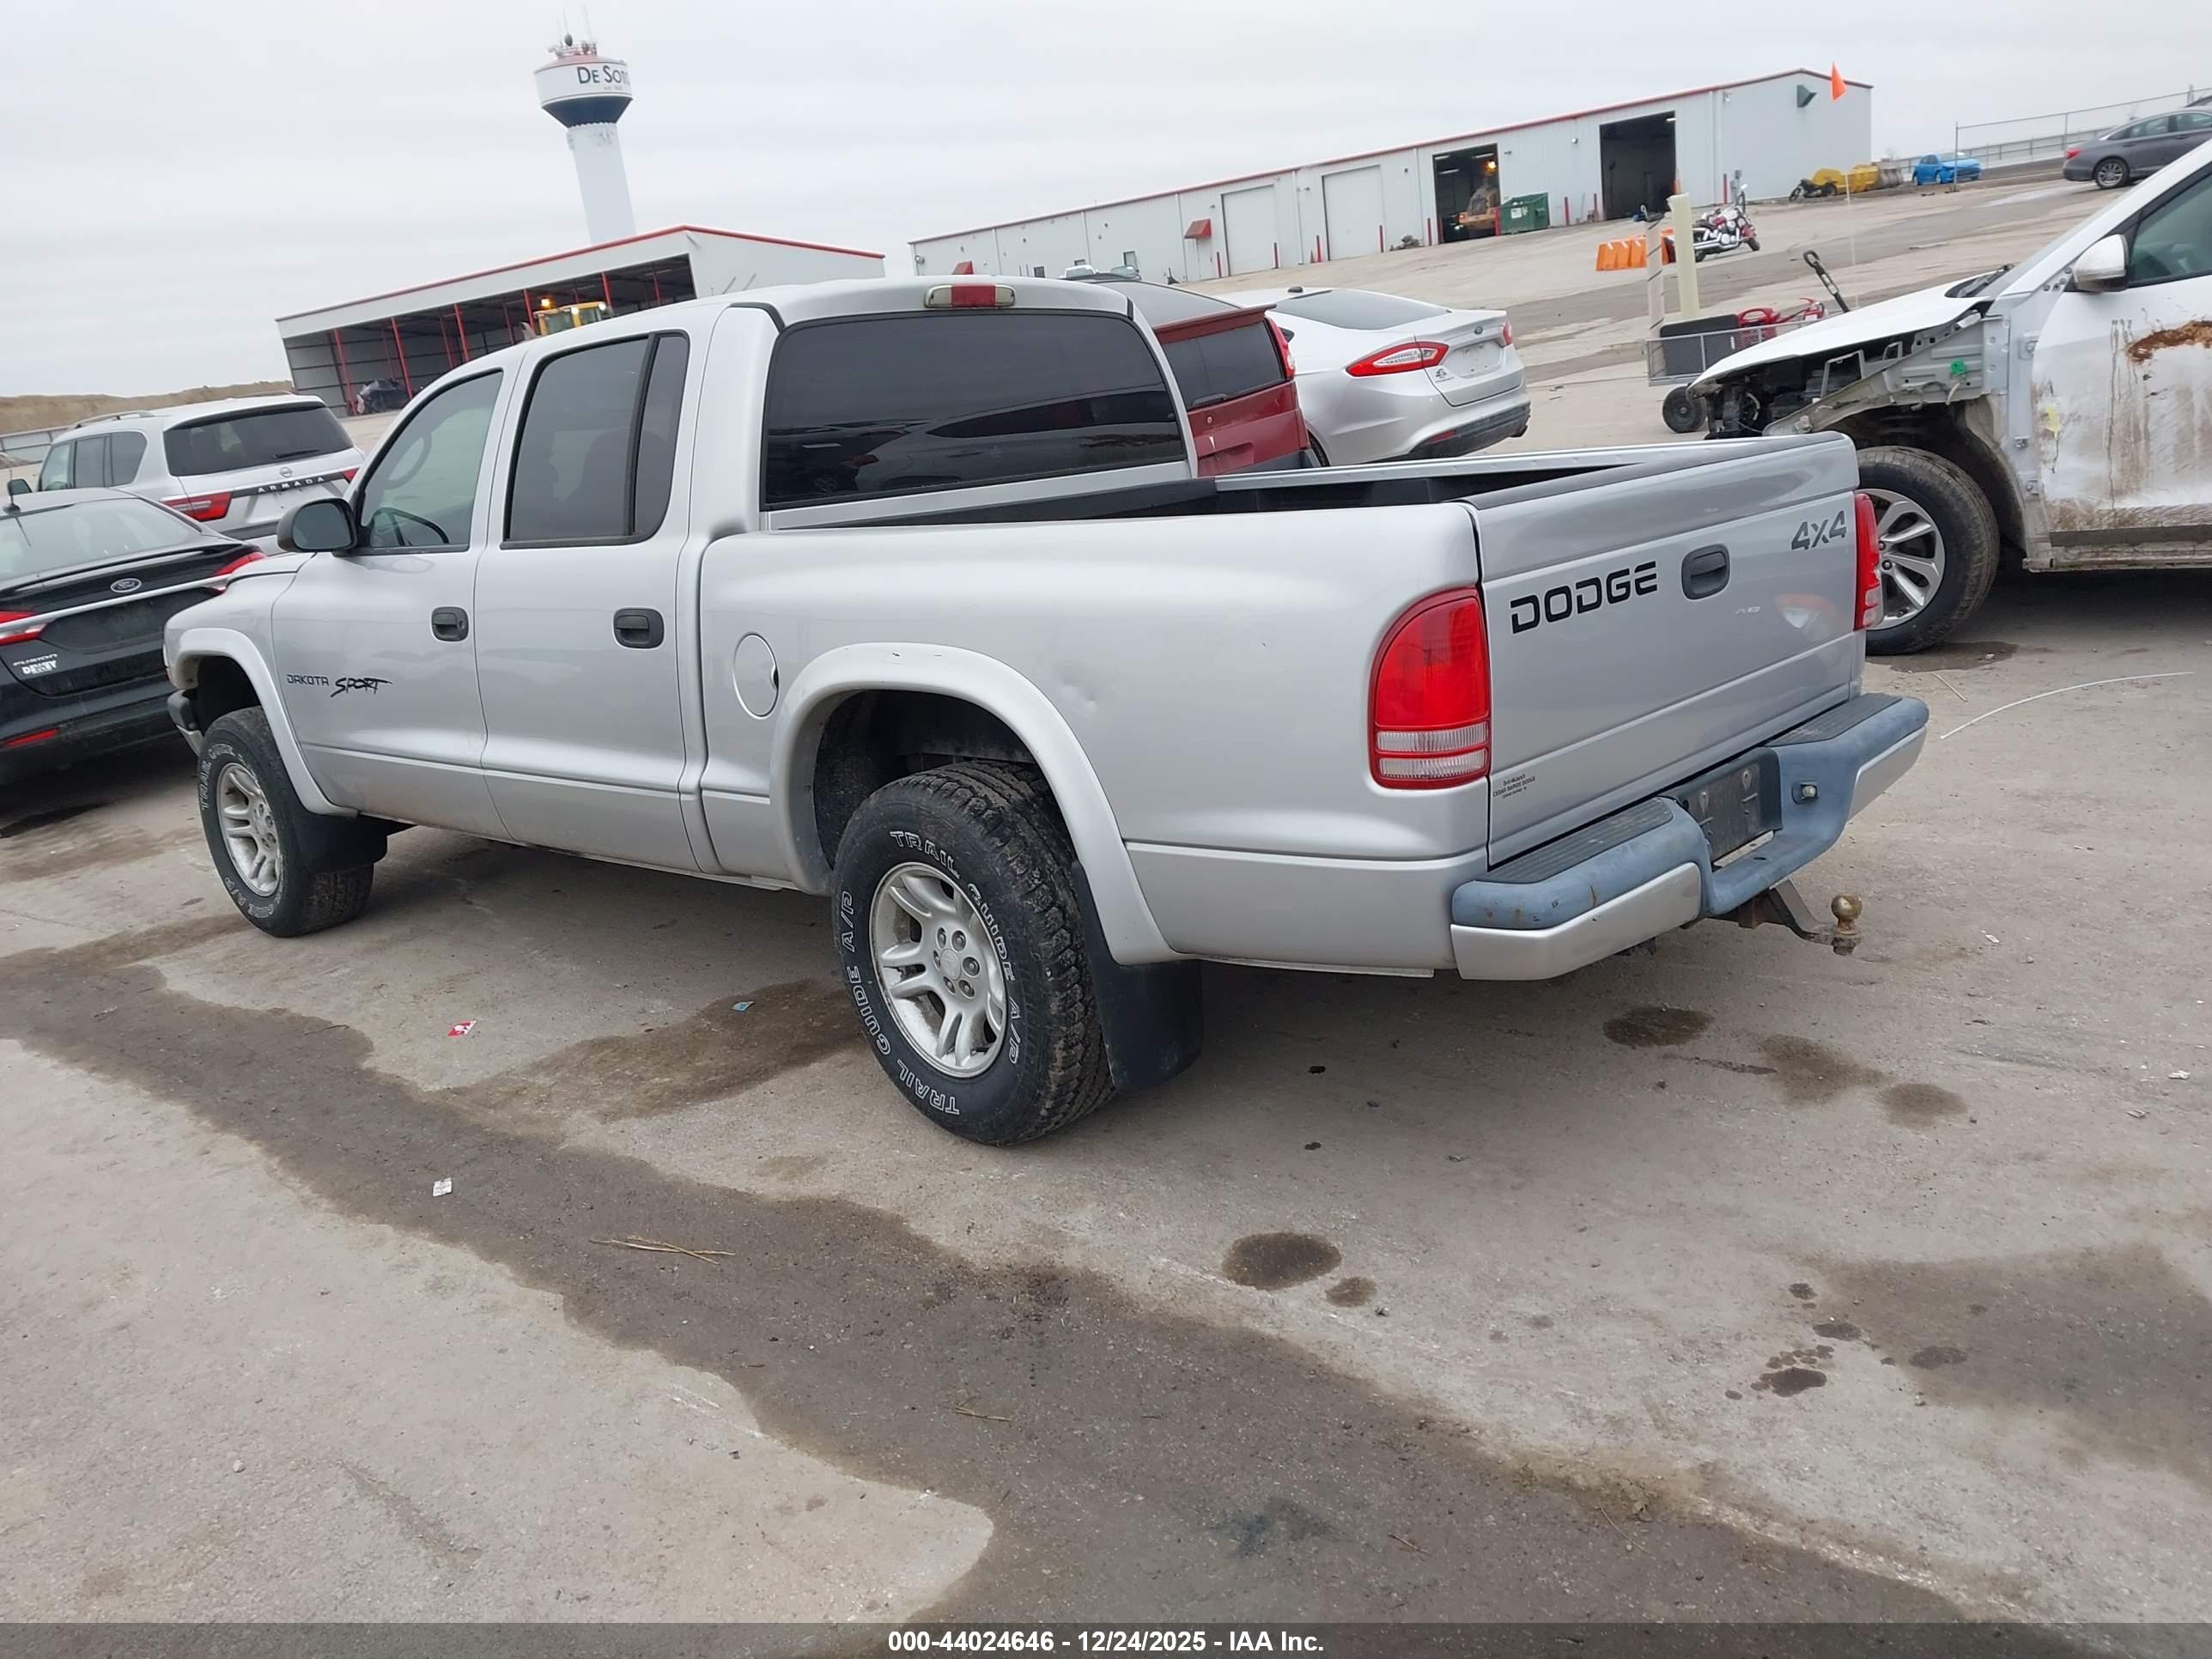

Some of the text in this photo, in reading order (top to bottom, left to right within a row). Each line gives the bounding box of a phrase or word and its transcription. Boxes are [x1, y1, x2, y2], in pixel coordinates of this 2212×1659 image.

[258, 477, 325, 493] ARMADA
[1510, 560, 1658, 635] DODGE
[286, 674, 393, 698] DAKOTA SPORT
[890, 830, 961, 880] TRAIL
[968, 883, 1016, 981] GUIDE
[841, 890, 960, 1115] TRAIL GUIDE A/P
